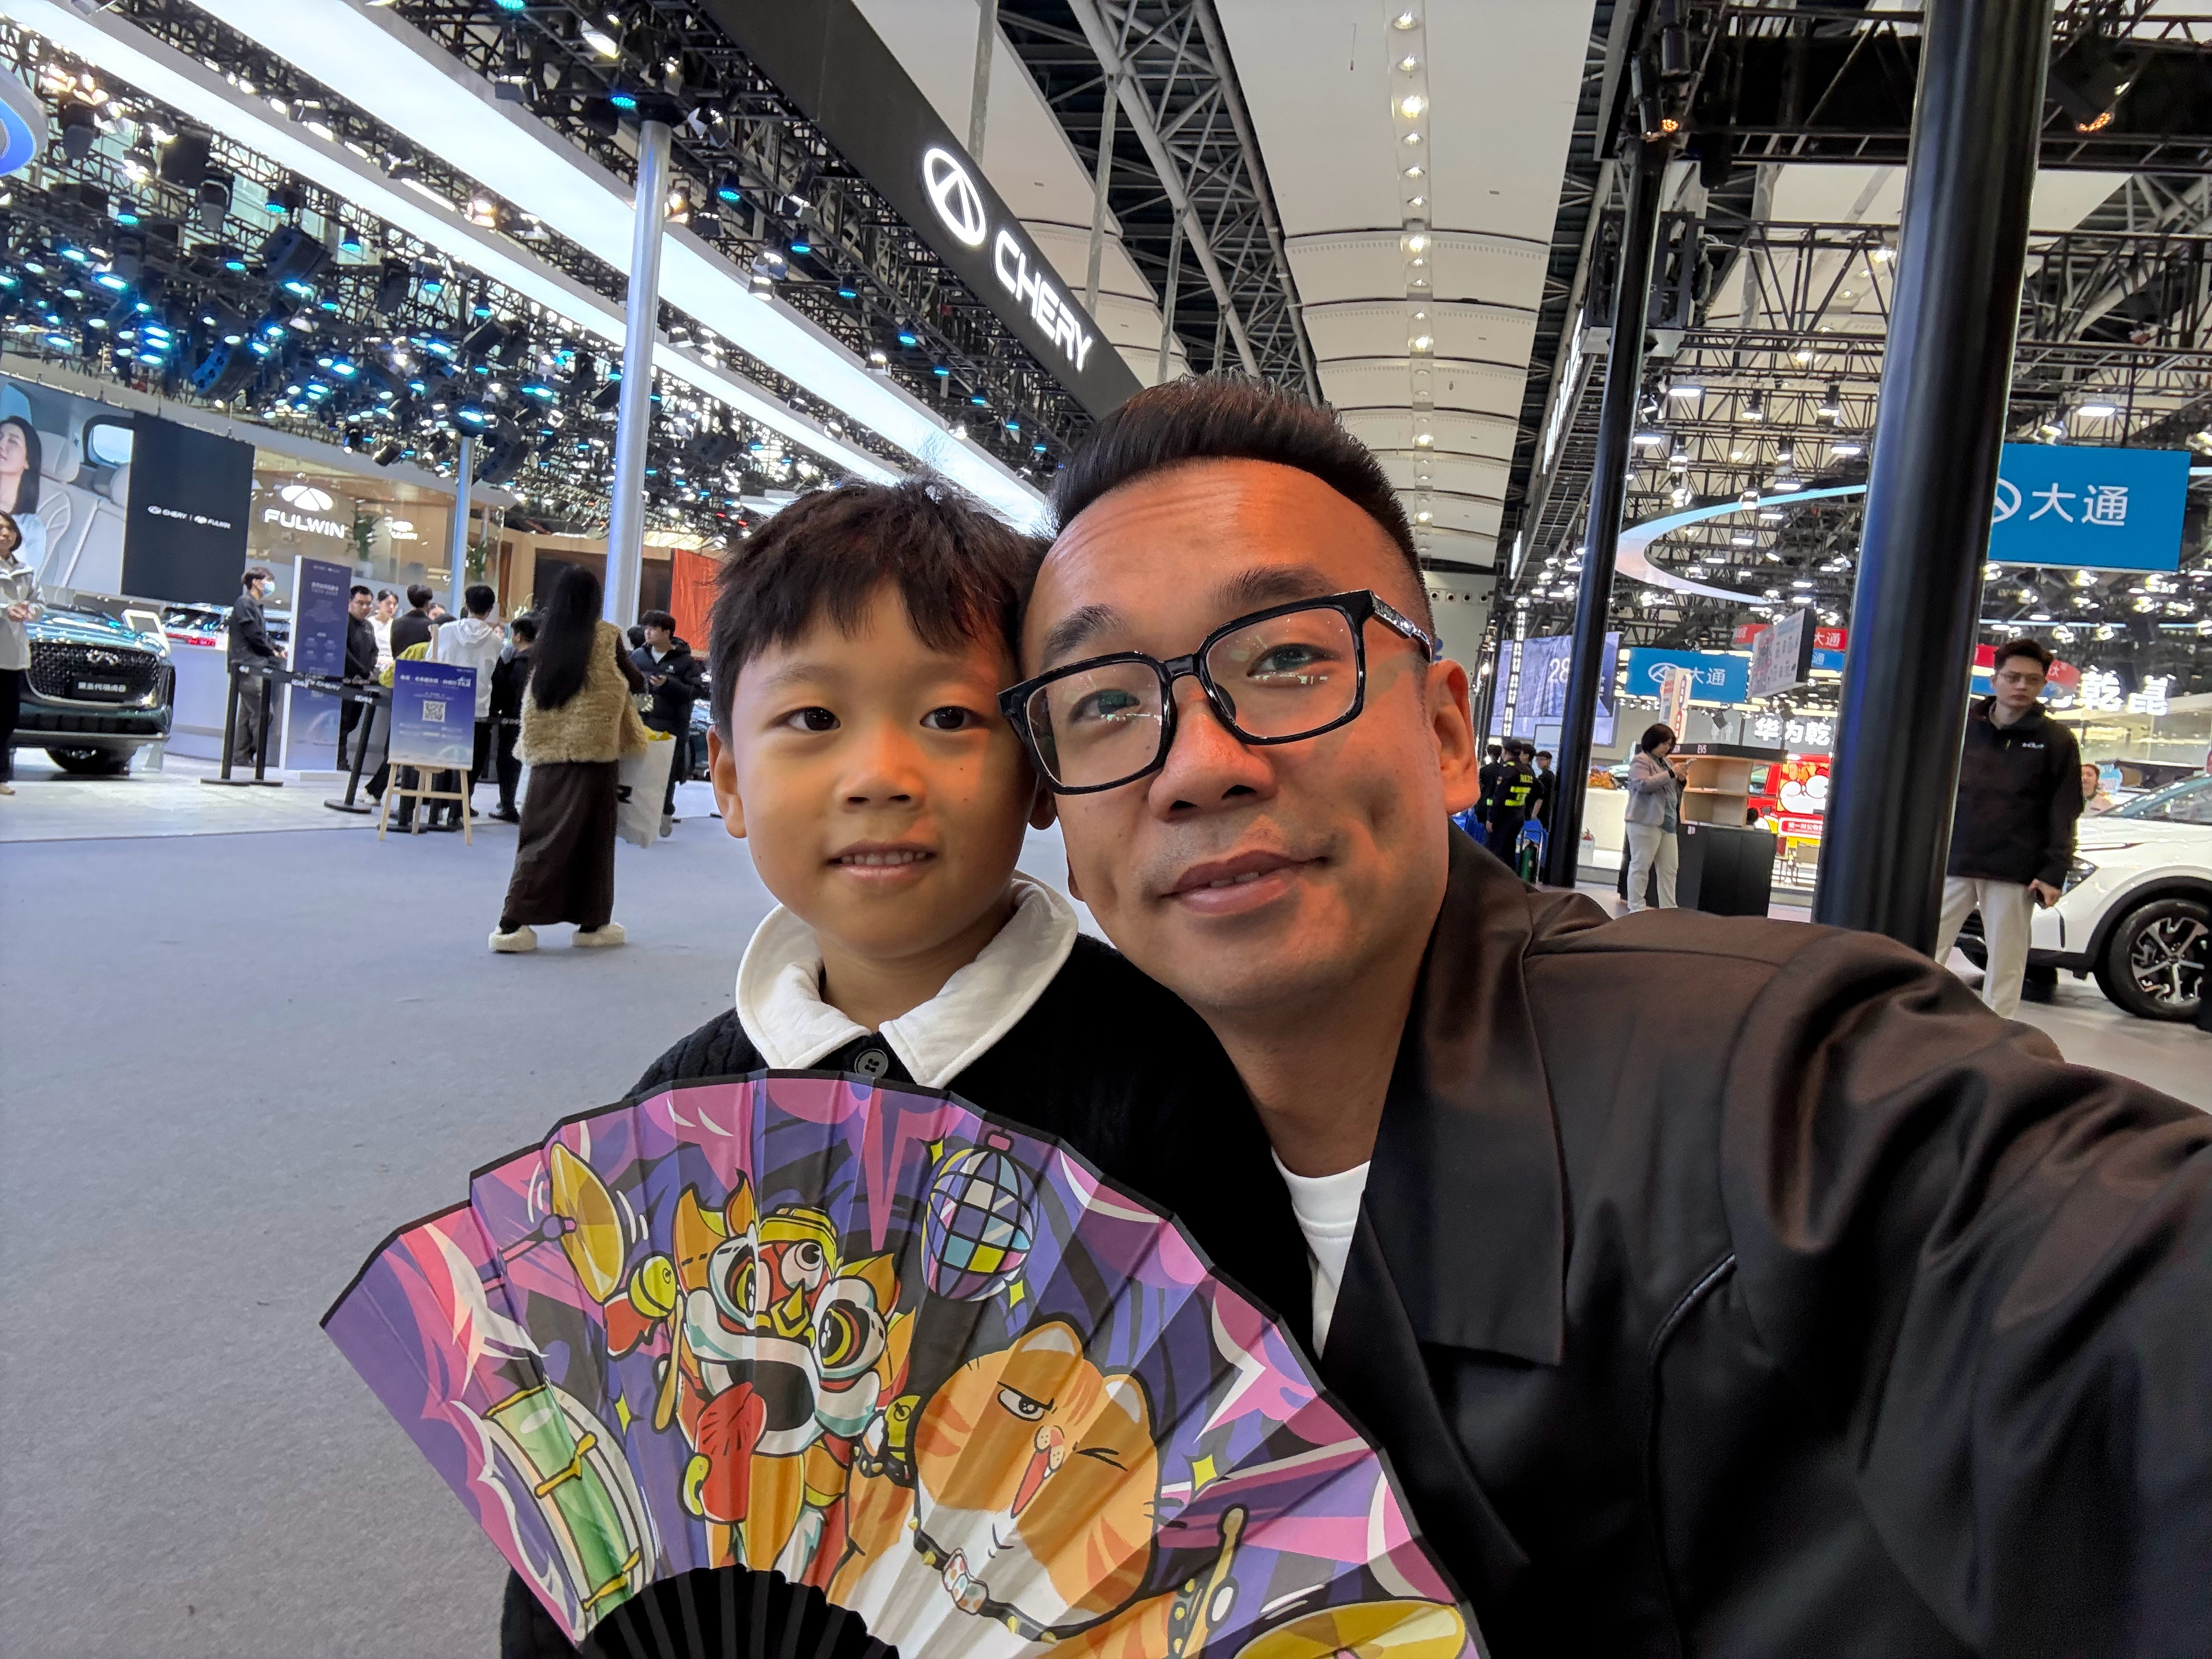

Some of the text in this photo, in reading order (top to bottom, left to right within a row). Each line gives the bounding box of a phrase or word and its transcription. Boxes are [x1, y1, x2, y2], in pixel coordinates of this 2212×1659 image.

[995, 229, 1093, 372] CHERY
[264, 508, 346, 539] FULWIN
[2028, 482, 2129, 527] 大通
